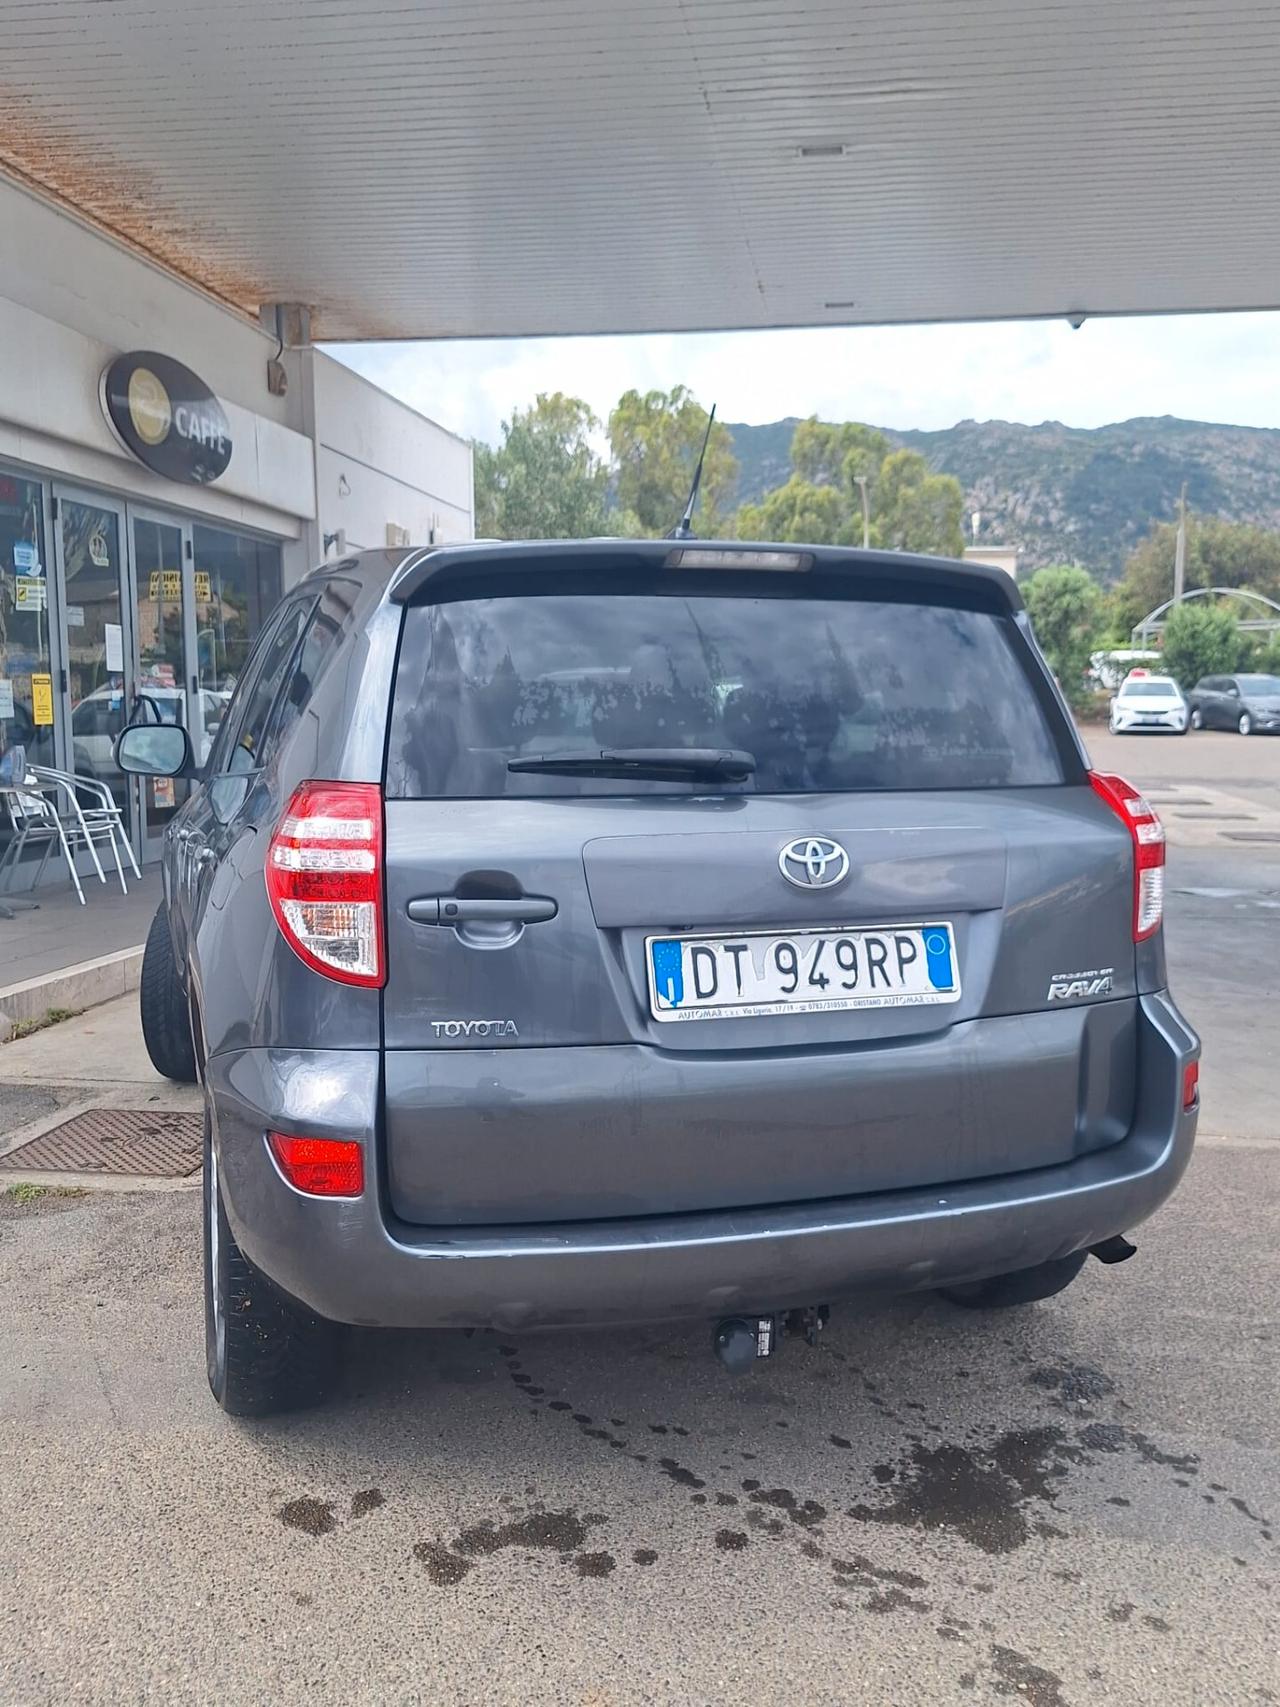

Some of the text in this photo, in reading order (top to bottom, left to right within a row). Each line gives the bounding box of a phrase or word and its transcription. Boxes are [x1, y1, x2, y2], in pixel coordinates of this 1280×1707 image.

[690, 935, 919, 999] DT 949RP
[1047, 976, 1113, 1001] RAV4
[431, 1020, 519, 1038] TOYOTA
